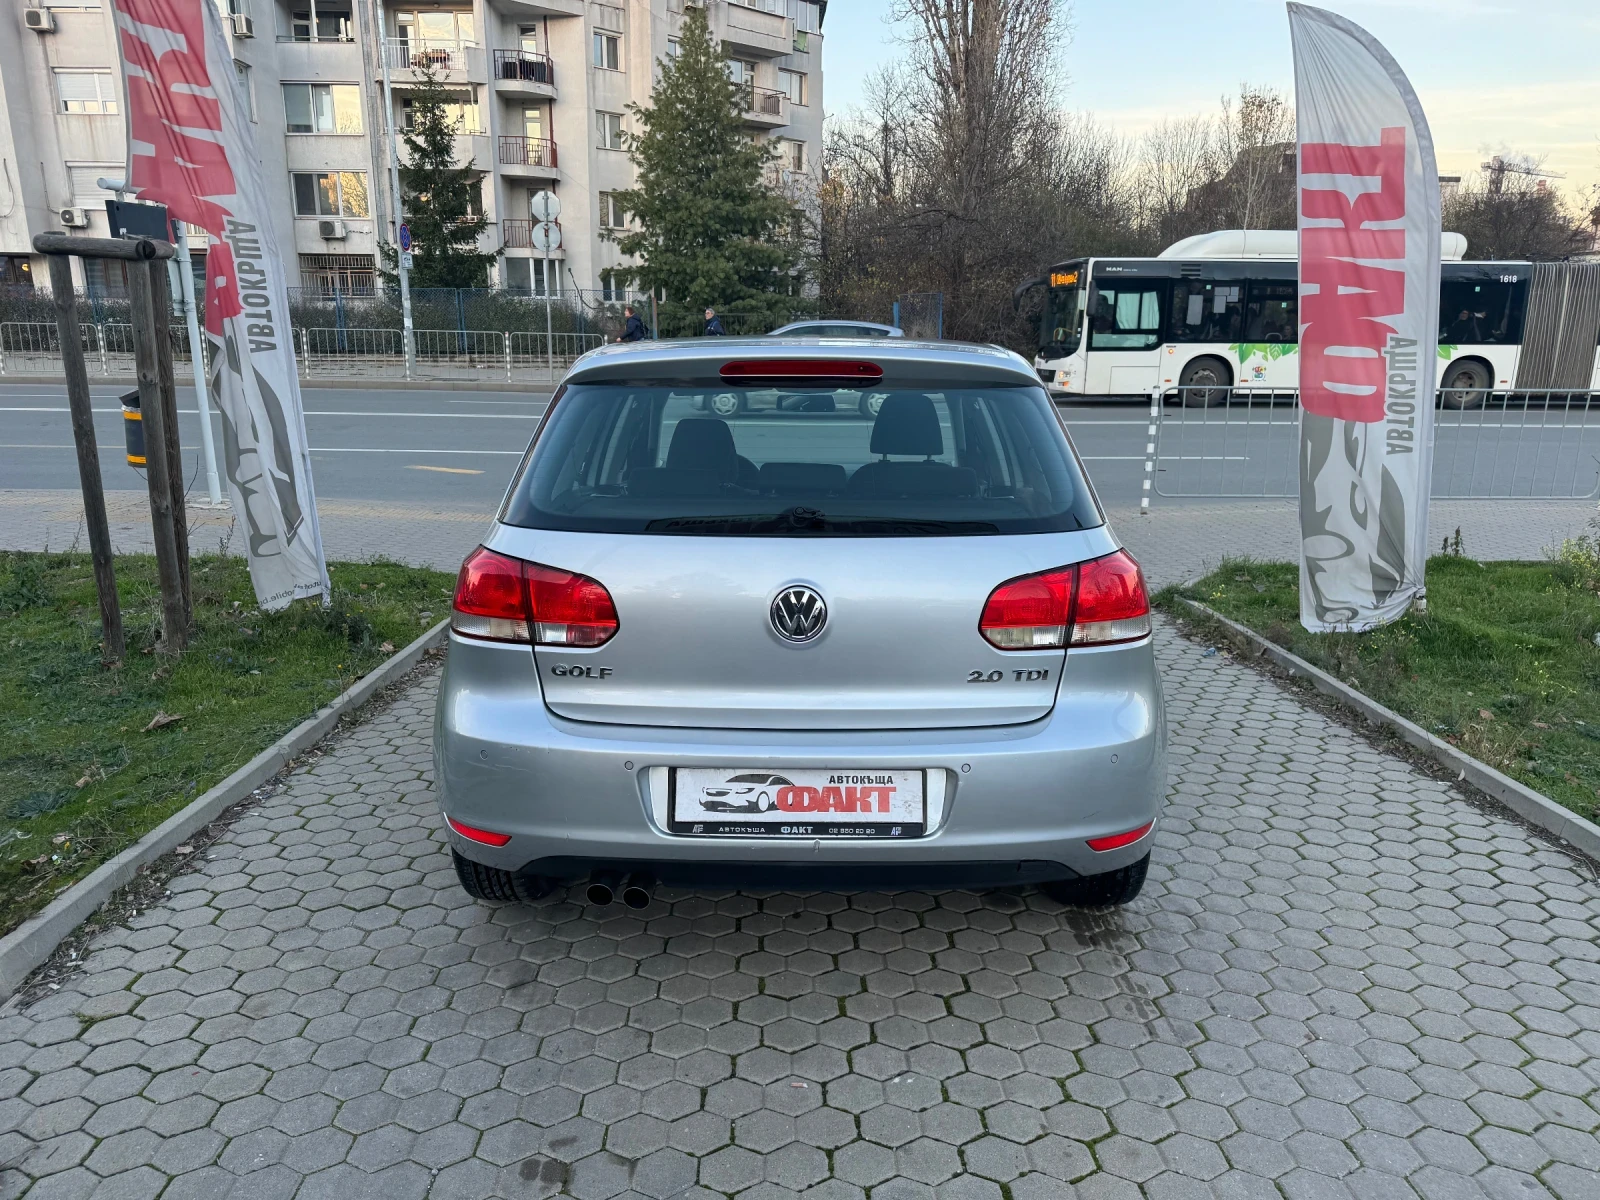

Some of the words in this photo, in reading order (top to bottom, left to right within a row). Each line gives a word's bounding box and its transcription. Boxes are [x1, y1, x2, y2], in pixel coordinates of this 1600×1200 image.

[1499, 275, 1518, 283] 1618
[551, 663, 614, 679] GOLF
[967, 669, 1003, 683] 2.0
[1012, 668, 1049, 682] TDI
[828, 775, 894, 786] АВТОКЪЩА
[776, 786, 897, 813] ФАКТ
[781, 825, 814, 834] ФАКТ
